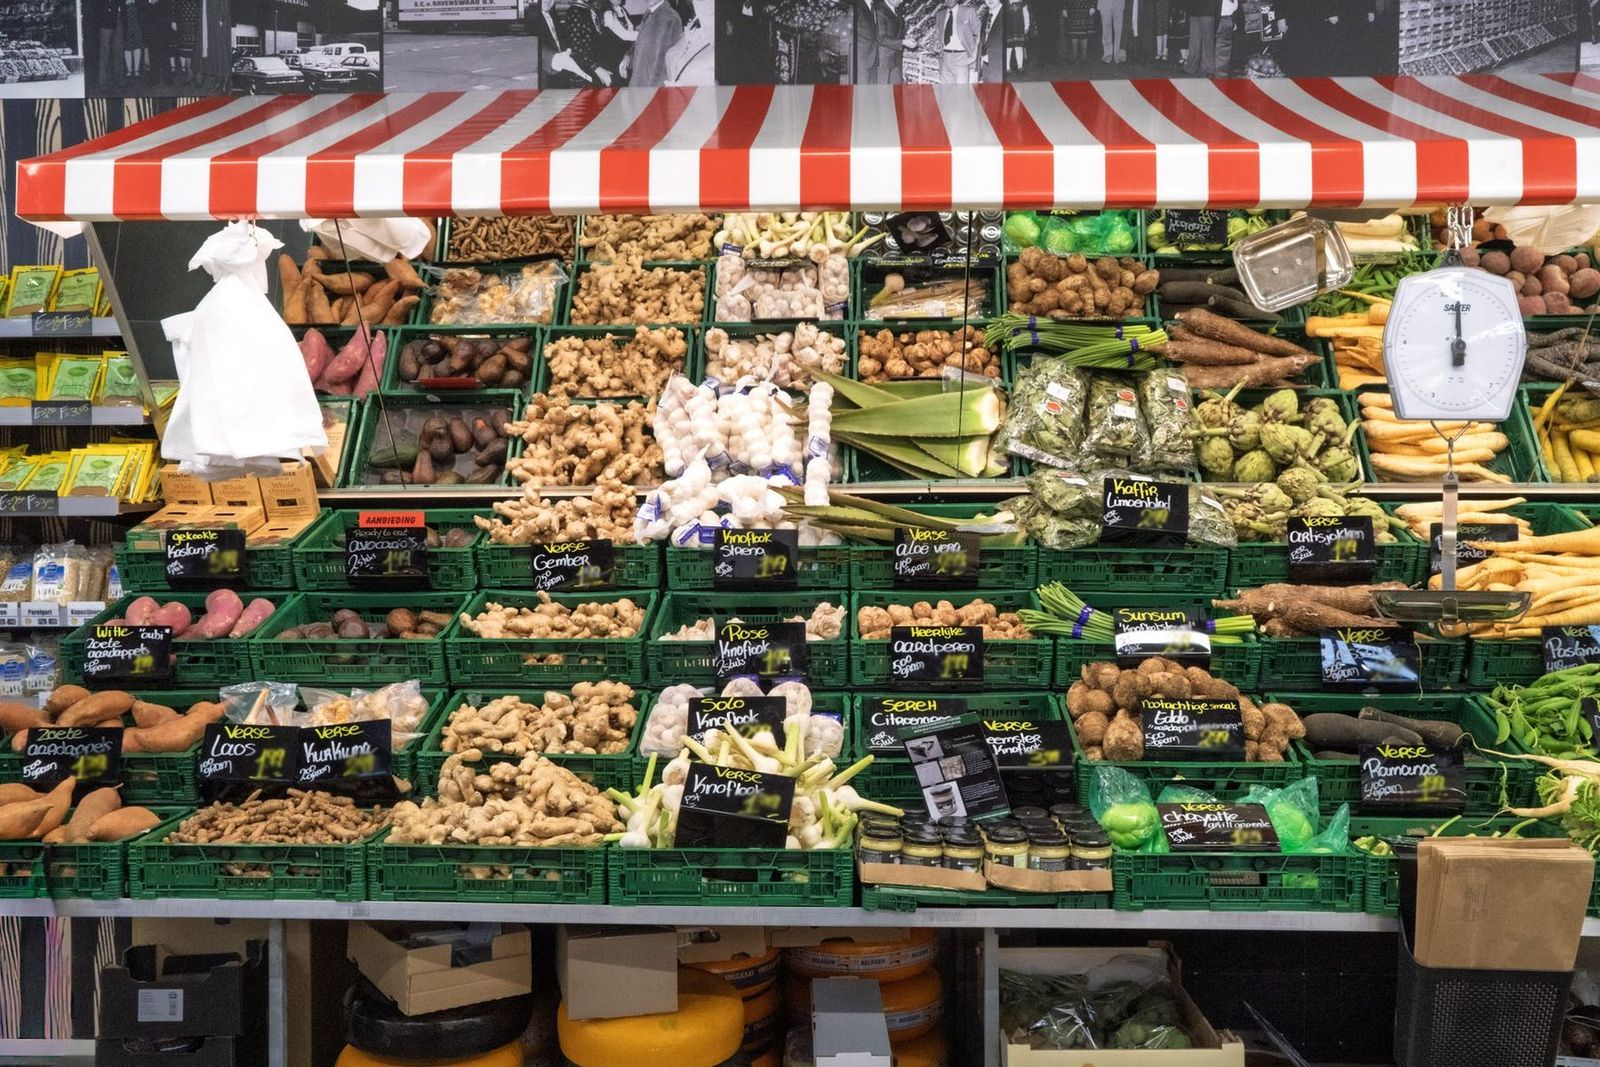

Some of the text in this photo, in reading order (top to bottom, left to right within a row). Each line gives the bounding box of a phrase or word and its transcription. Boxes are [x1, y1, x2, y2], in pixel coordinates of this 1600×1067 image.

[1114, 479, 1158, 498] Kaffir
[1302, 516, 1342, 527] Verse
[723, 530, 772, 546] Knoflook
[909, 528, 949, 540] Verse
[544, 541, 590, 553] Verse
[534, 554, 590, 571] Gember
[1118, 608, 1186, 623] Sunsum
[97, 626, 134, 638] Witte
[721, 624, 770, 642] Rosé
[1337, 628, 1391, 643] Verse
[86, 638, 122, 649] Zoete
[701, 696, 745, 712] Solo
[1154, 710, 1189, 725] Eddo
[224, 725, 275, 739] Verse
[315, 725, 364, 739] Verse
[983, 721, 1039, 731] Verse
[37, 728, 89, 741] Zoete
[985, 733, 1042, 744] eemster
[211, 734, 256, 757] Laos
[1376, 744, 1435, 759] Verse
[715, 767, 763, 783] Verse
[1181, 801, 1232, 811] Verse
